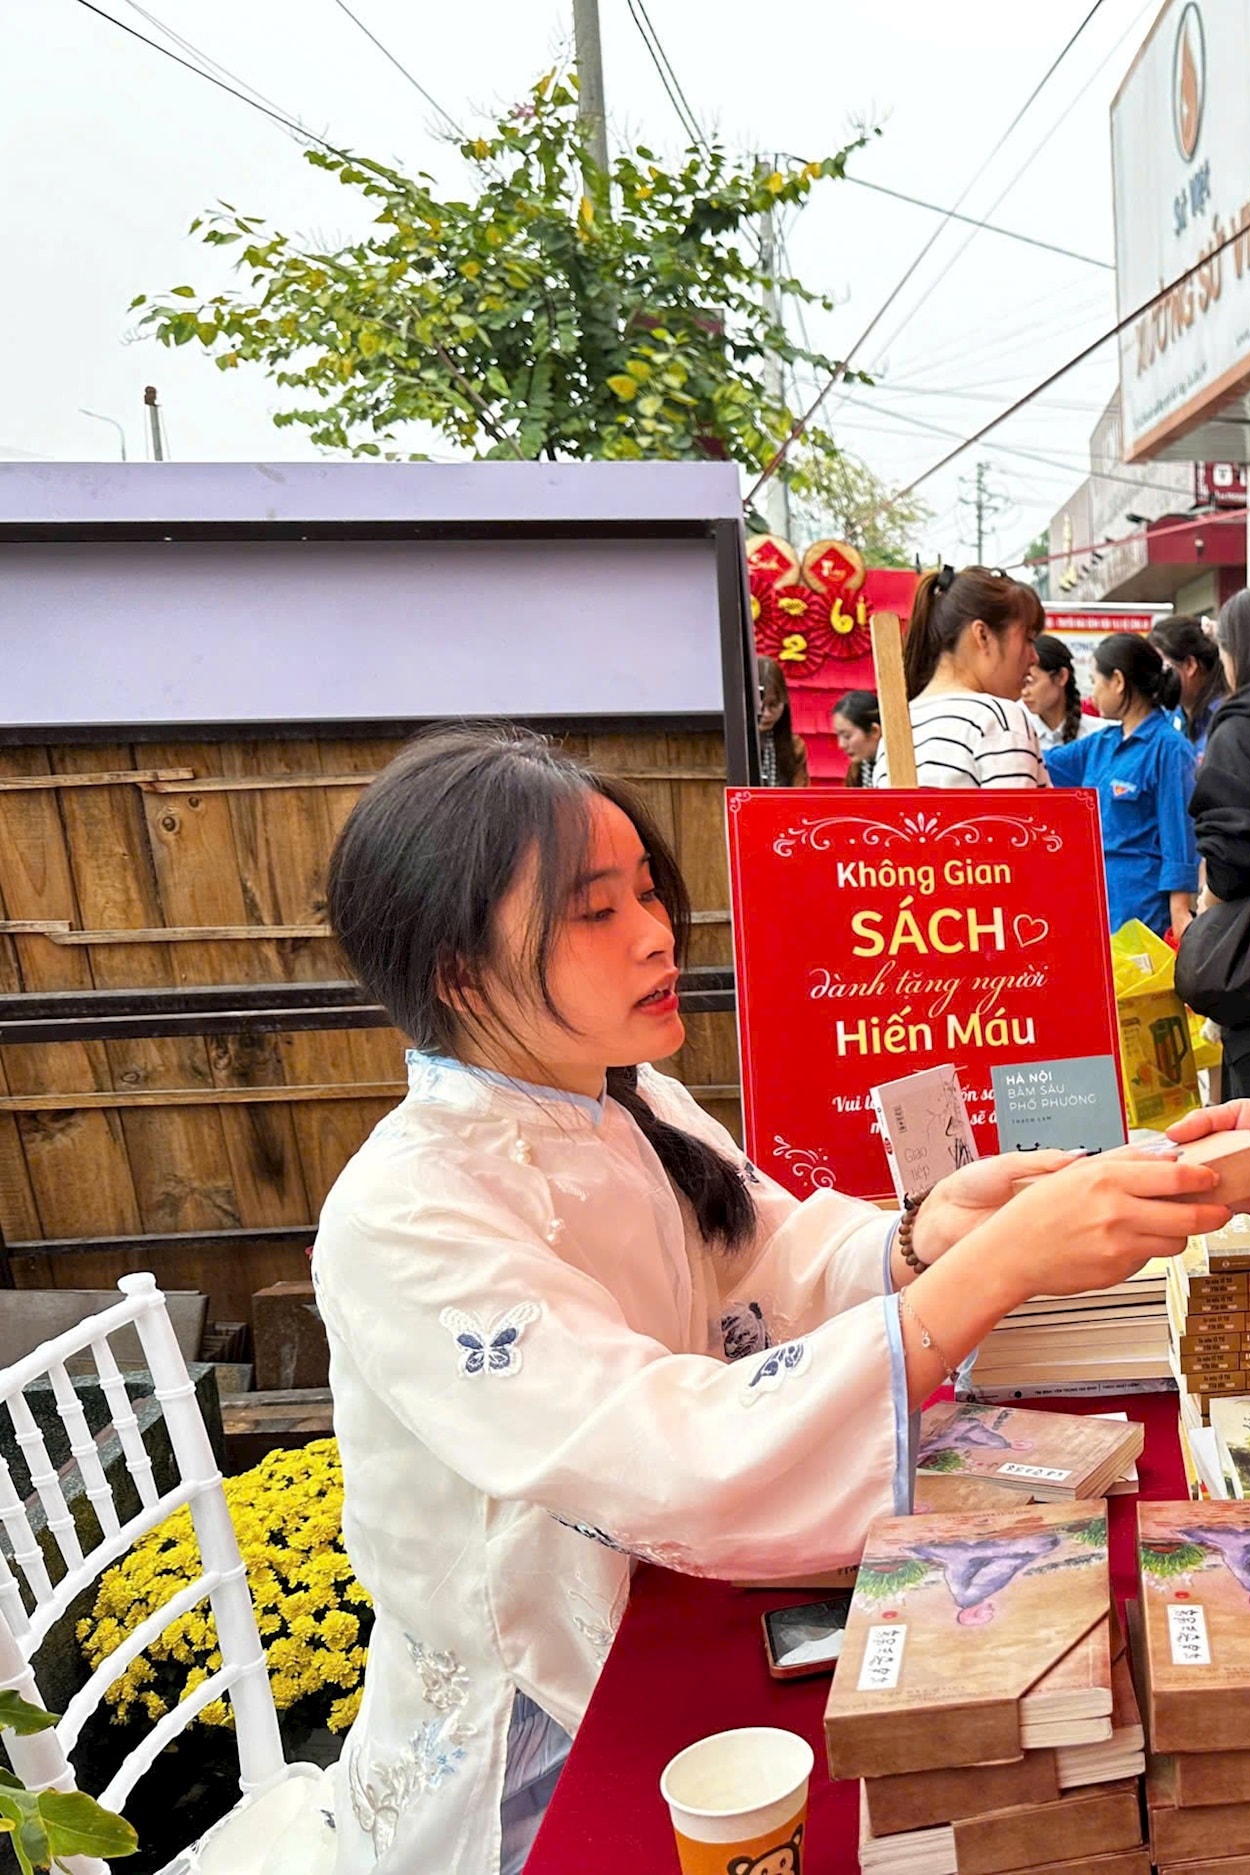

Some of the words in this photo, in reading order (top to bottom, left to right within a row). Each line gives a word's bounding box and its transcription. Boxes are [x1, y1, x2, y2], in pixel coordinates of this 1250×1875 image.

[1199, 213, 1226, 314] SỨ
[830, 597, 854, 634] 6
[779, 633, 807, 661] 2
[836, 859, 935, 895] Không
[943, 858, 1012, 885] Gian
[851, 895, 1006, 958] SÁCH
[808, 960, 896, 999] dành
[895, 969, 962, 1018] tặng
[971, 964, 1048, 1015] người
[835, 1005, 933, 1056] Hiến
[946, 1007, 1036, 1049] Máu
[1006, 1072, 1025, 1085] HÀ
[1029, 1069, 1053, 1084] NỘI
[832, 1094, 862, 1113] Vui
[969, 1110, 985, 1125] sẽ
